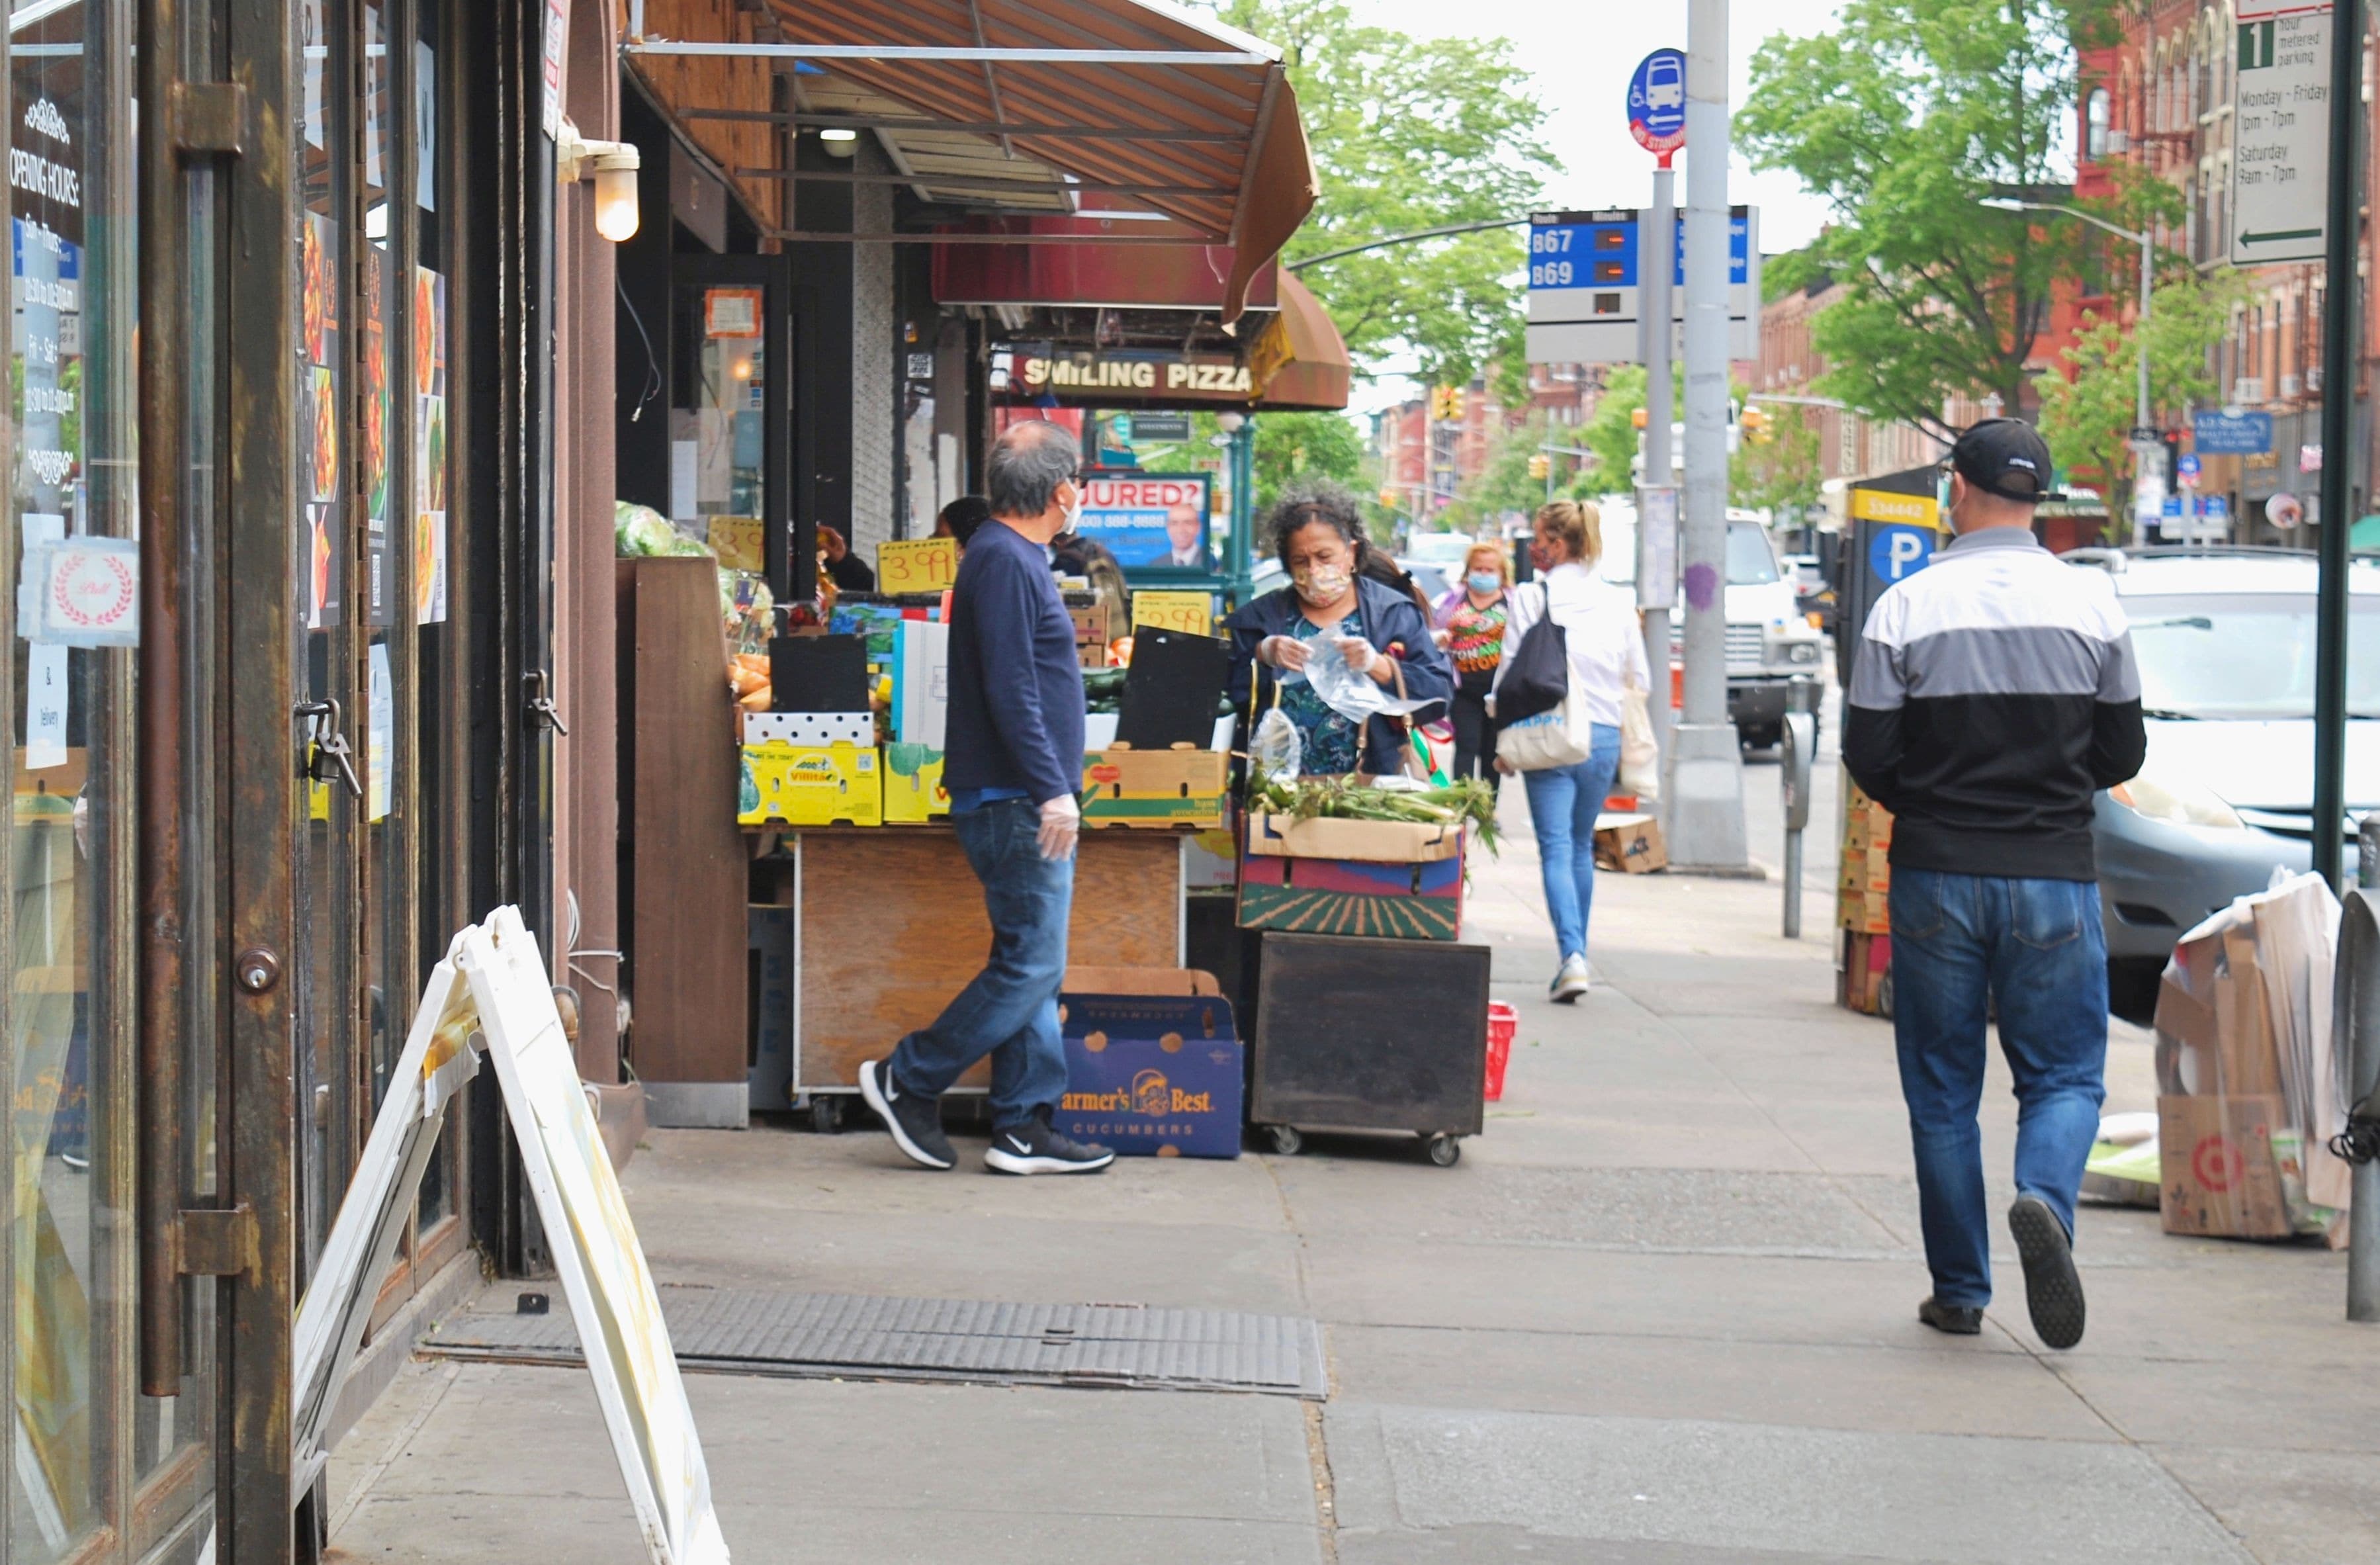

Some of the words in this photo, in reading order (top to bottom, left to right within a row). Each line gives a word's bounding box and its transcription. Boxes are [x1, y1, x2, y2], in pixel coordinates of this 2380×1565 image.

[2250, 23, 2262, 67] 1
[2279, 32, 2319, 48] metered
[2277, 51, 2314, 69] parking
[2241, 87, 2282, 109] Monday
[2293, 83, 2327, 103] Friday
[2241, 114, 2261, 134] 1pm
[2271, 111, 2295, 130] 7pm
[2240, 144, 2287, 163] Saturday
[10, 147, 46, 196] OPENING
[48, 161, 79, 208] HOURS:
[2239, 168, 2262, 185] 9am
[2273, 165, 2296, 184] 7pm
[1532, 229, 1573, 253] B67
[1532, 261, 1573, 285] B69
[1024, 358, 1156, 388] SMILING
[1168, 364, 1253, 392] PIZZA
[1080, 482, 1198, 506] JURED?
[1890, 532, 1923, 579] P
[1061, 1086, 1130, 1112] armer's
[1170, 1088, 1211, 1112] Best
[1073, 1123, 1193, 1135] CUCUMBERS
